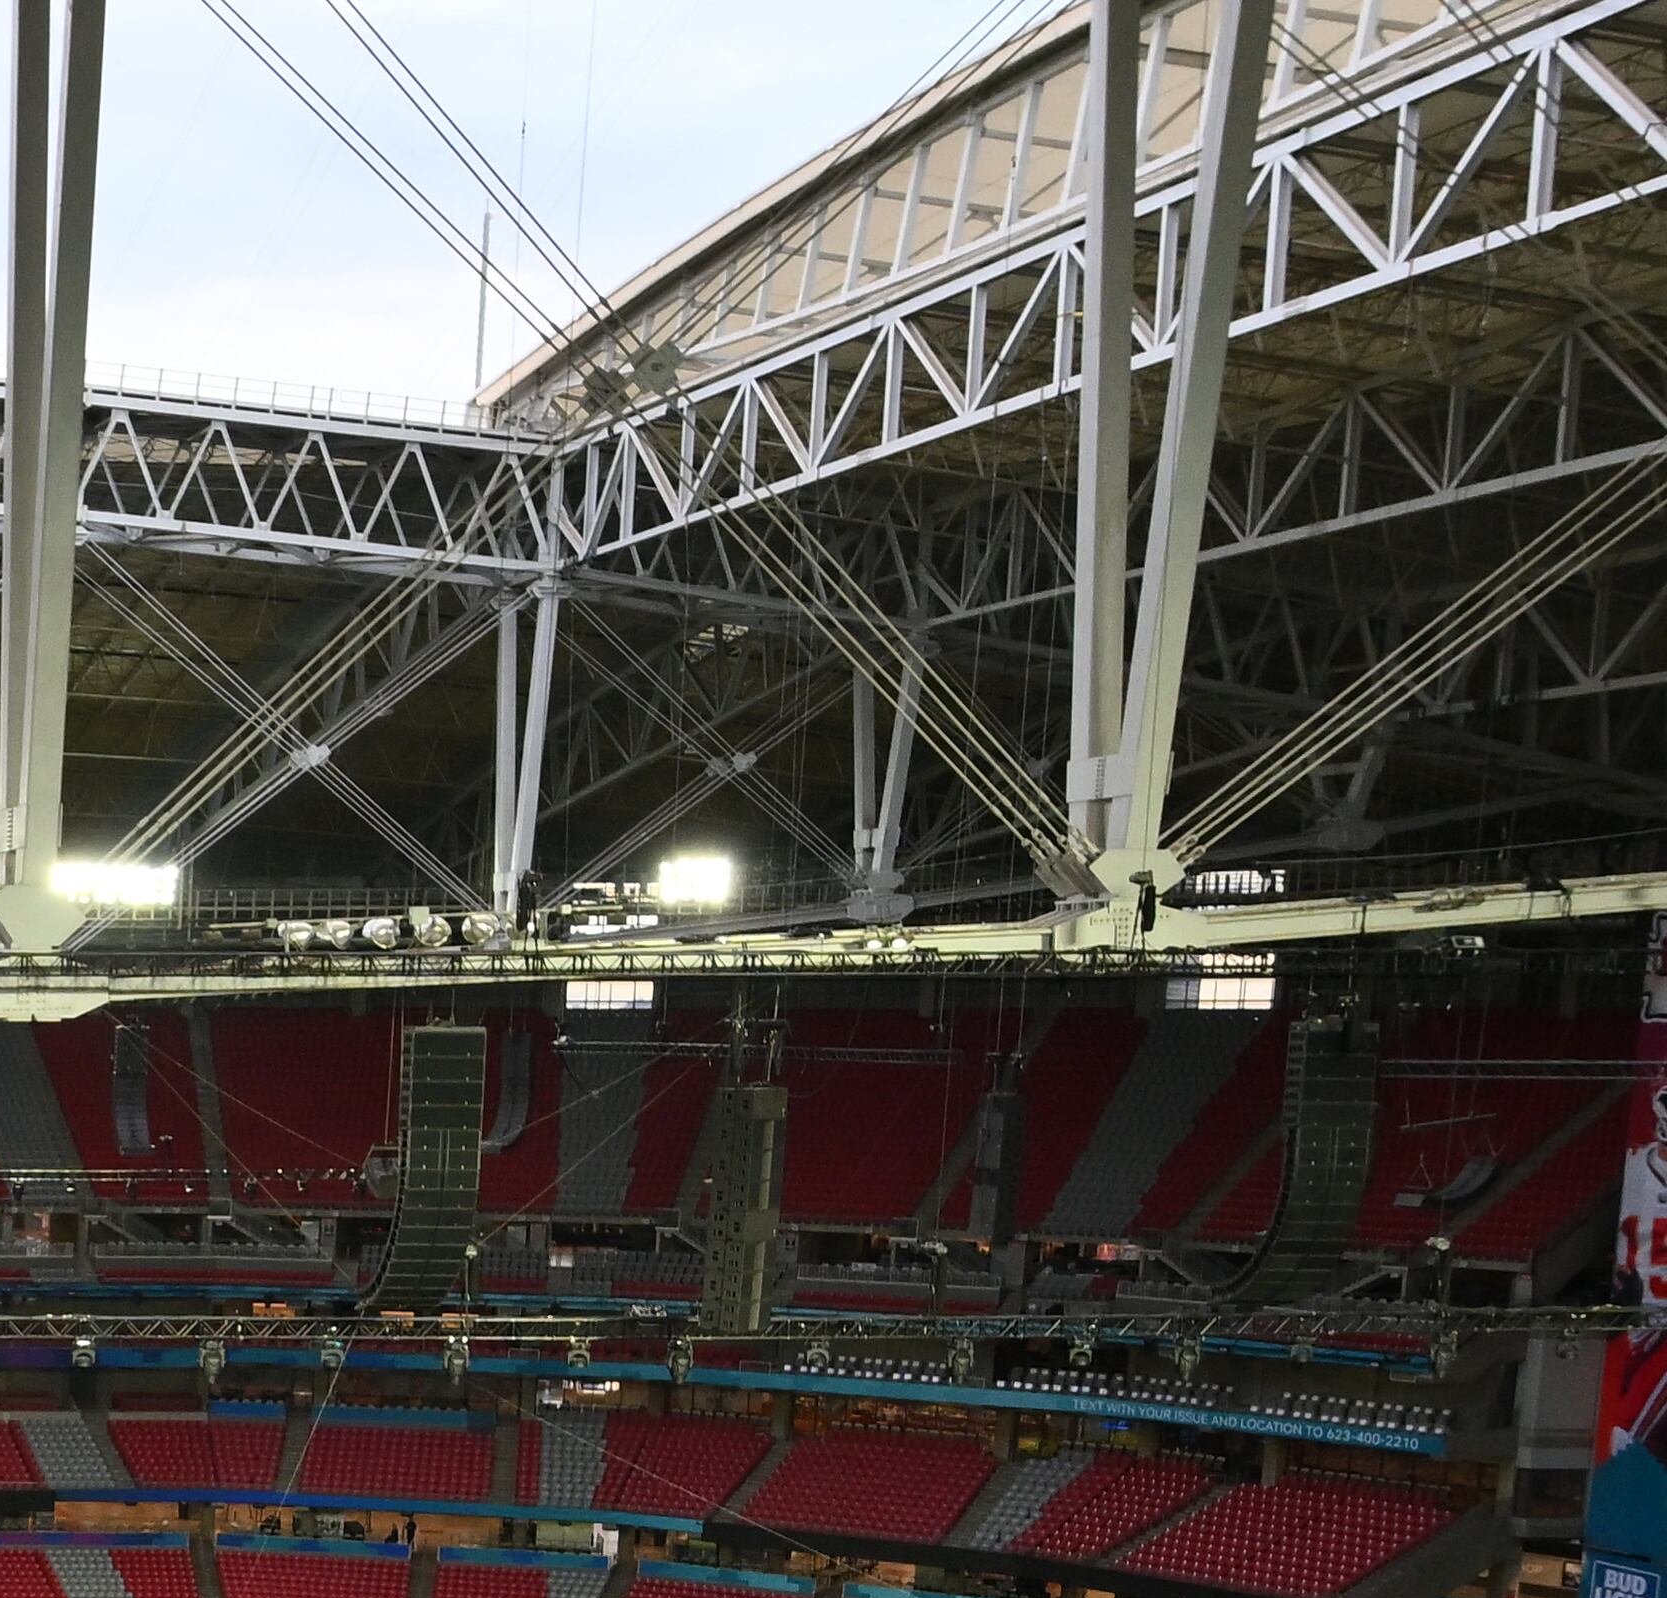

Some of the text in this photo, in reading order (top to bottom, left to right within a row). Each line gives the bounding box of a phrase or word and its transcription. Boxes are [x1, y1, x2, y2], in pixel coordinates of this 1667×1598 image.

[1072, 1399, 1419, 1450] TEXT WITH YOUR ISSUE AND LOCATION TO 623-400-2210
[1603, 1568, 1647, 1595] BUD
